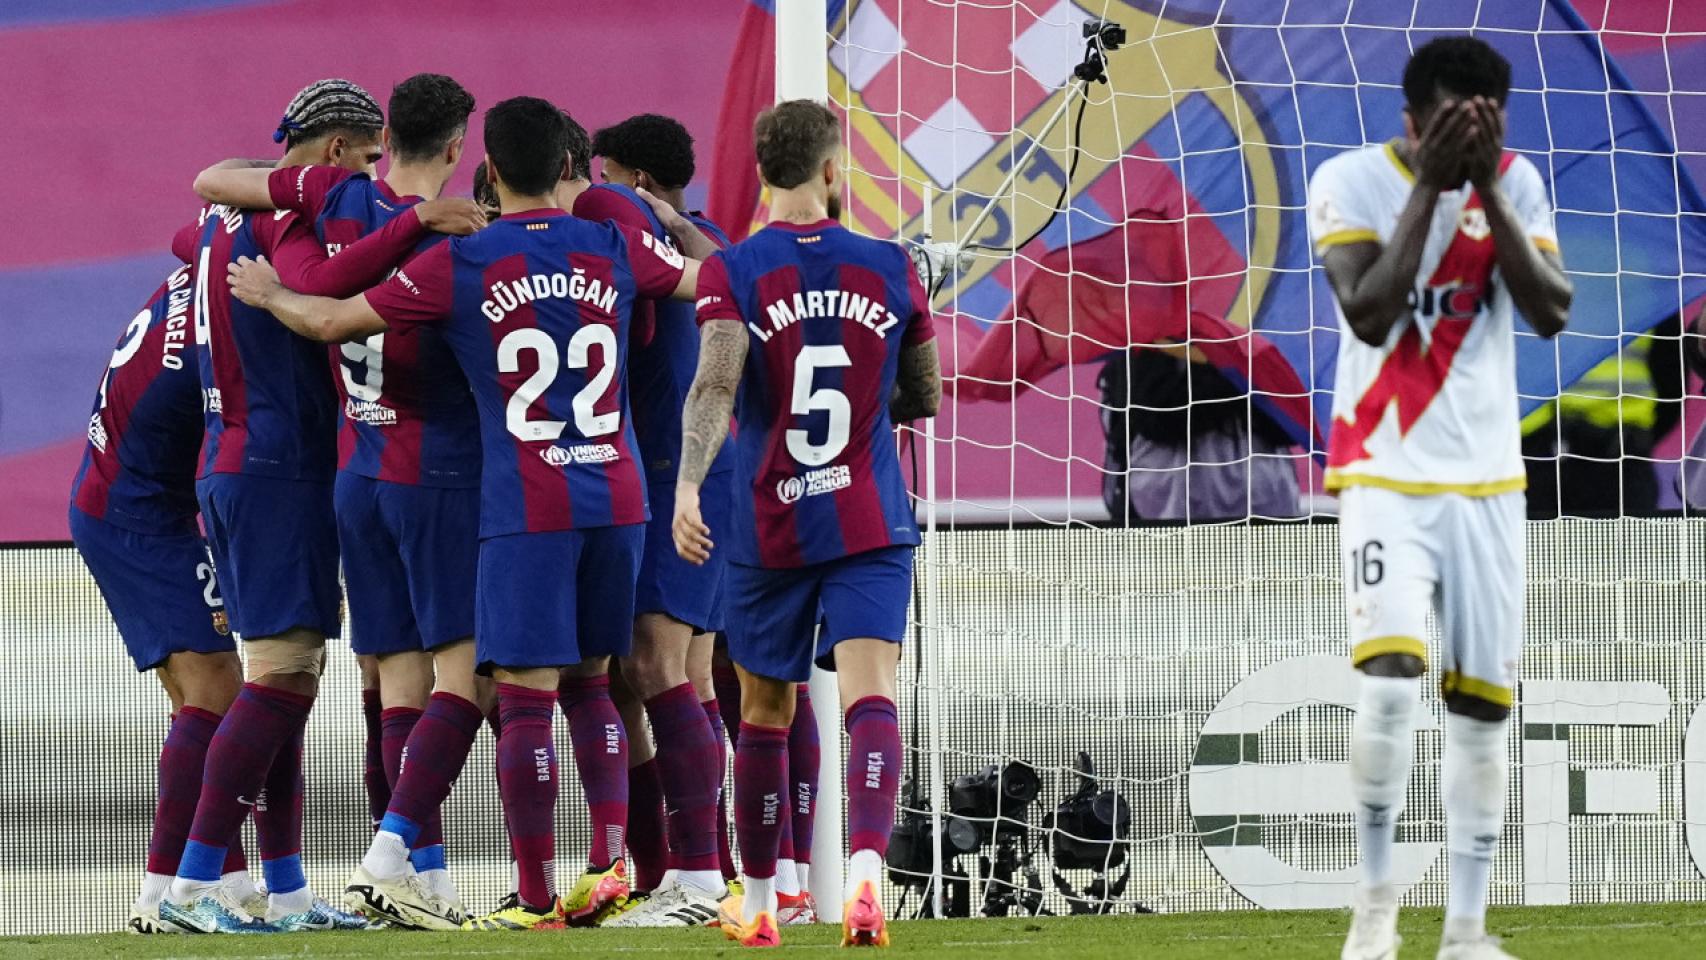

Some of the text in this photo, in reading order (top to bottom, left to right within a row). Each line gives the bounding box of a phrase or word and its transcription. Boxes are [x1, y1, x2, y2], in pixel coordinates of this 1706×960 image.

[481, 268, 618, 323] GÜNDOĞAN
[749, 290, 899, 342] I. MARTINEZ
[162, 287, 191, 371] CANCELO
[339, 332, 385, 402] 9
[497, 323, 620, 442] 22
[785, 344, 853, 466] 5
[805, 465, 851, 482] UNHCR
[196, 562, 224, 607] 2
[1352, 540, 1383, 593] 16
[534, 748, 550, 782] BARÇA
[606, 723, 621, 755] BARÇA
[866, 751, 885, 789] BARÇA
[798, 782, 811, 815] BARÇA
